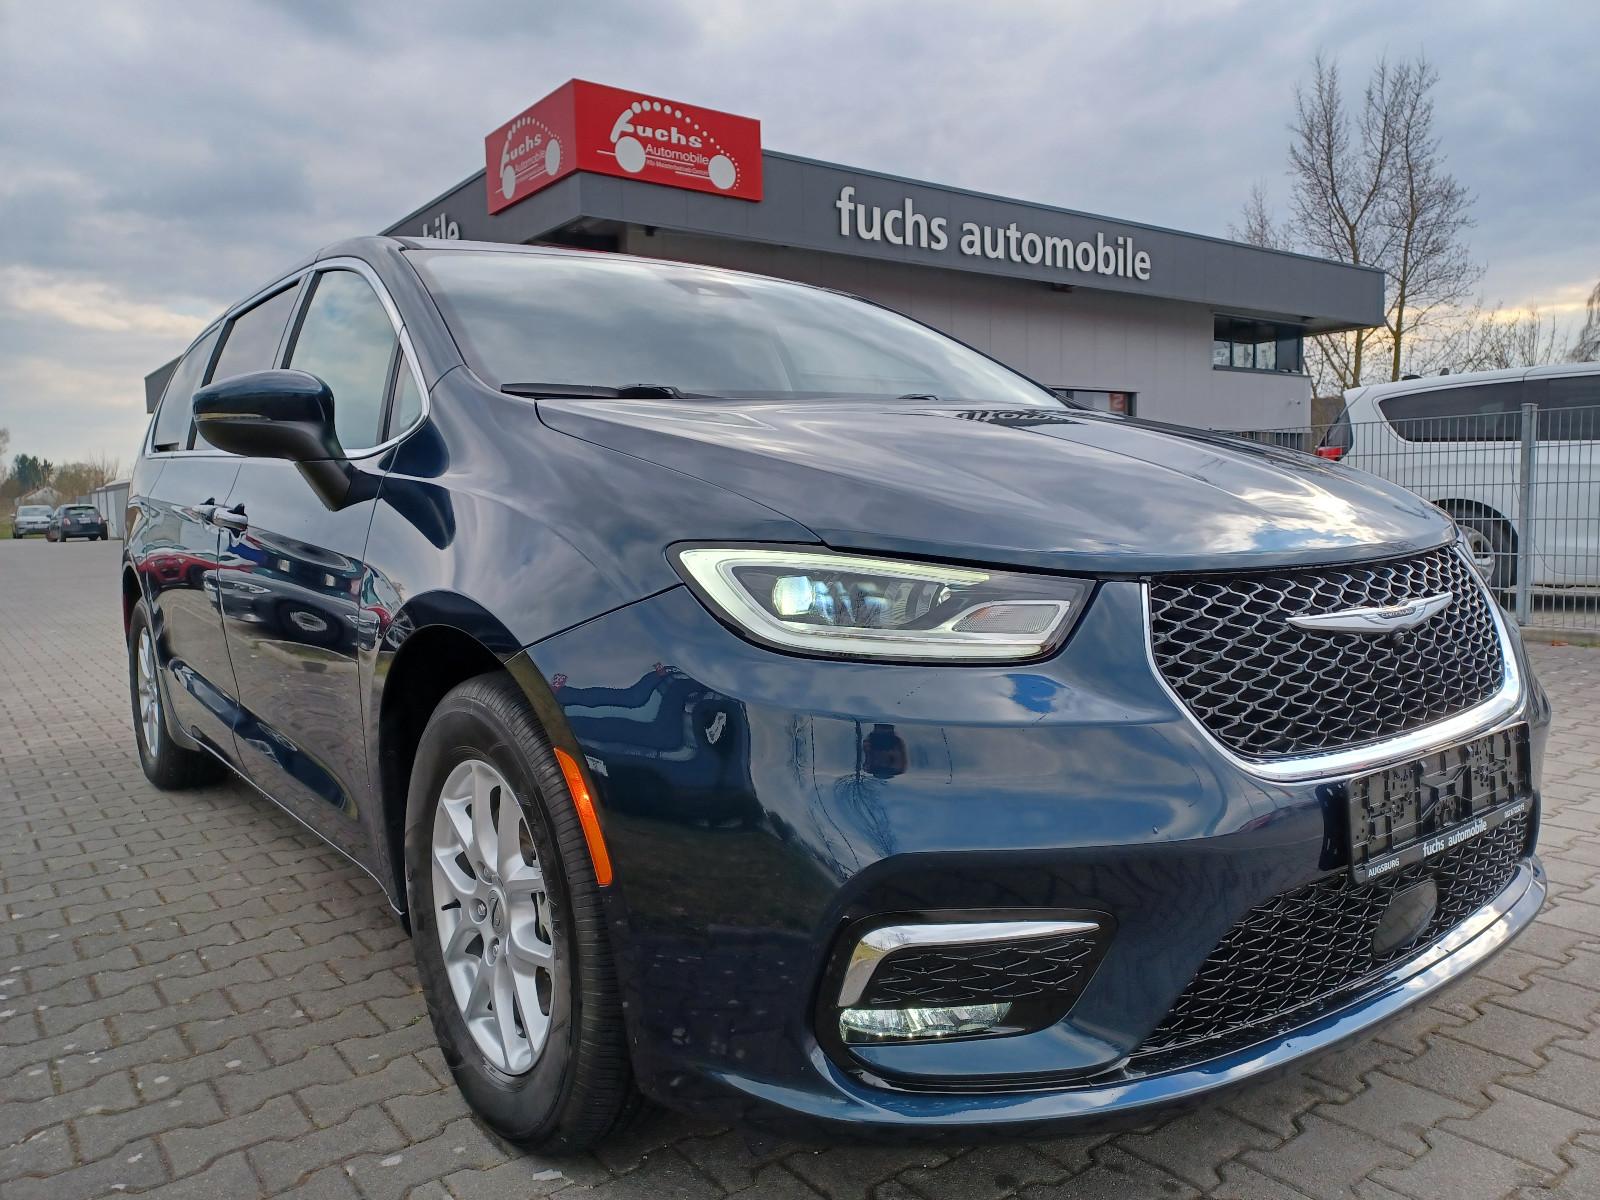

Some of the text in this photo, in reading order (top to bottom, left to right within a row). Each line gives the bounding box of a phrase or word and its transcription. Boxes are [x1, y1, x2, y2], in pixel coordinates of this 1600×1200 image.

[645, 143, 709, 165] Automobile
[836, 186, 1151, 281] fuchs automobile
[1422, 817, 1488, 857] fuchs automobile
[1368, 857, 1400, 877] AUGSBURG
